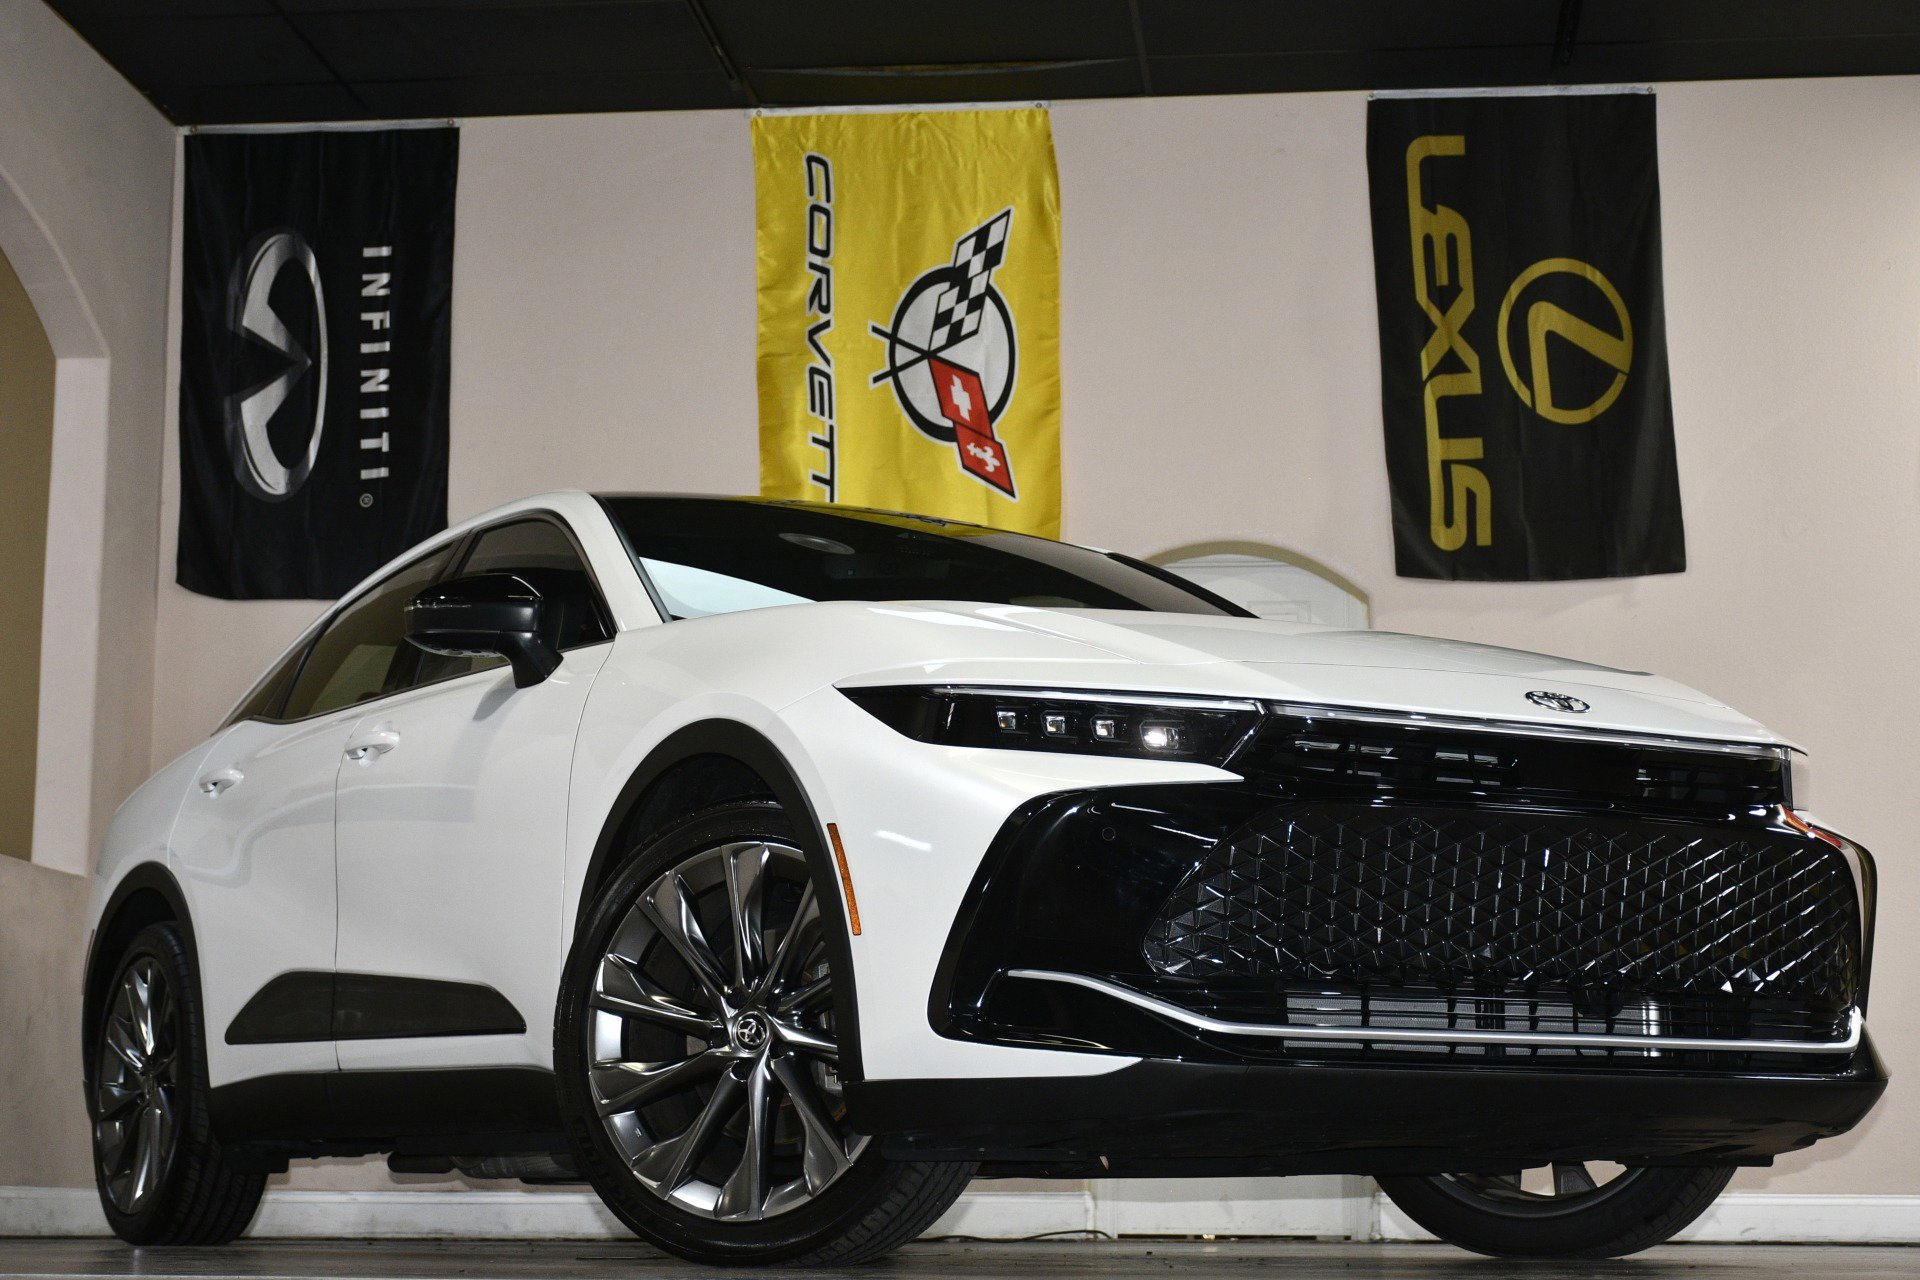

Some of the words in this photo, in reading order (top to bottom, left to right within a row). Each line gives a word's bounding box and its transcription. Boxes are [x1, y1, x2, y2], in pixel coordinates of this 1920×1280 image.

[360, 245, 392, 480] INFINITI
[805, 153, 837, 503] CORVETT
[1406, 136, 1492, 551] LEXUS
